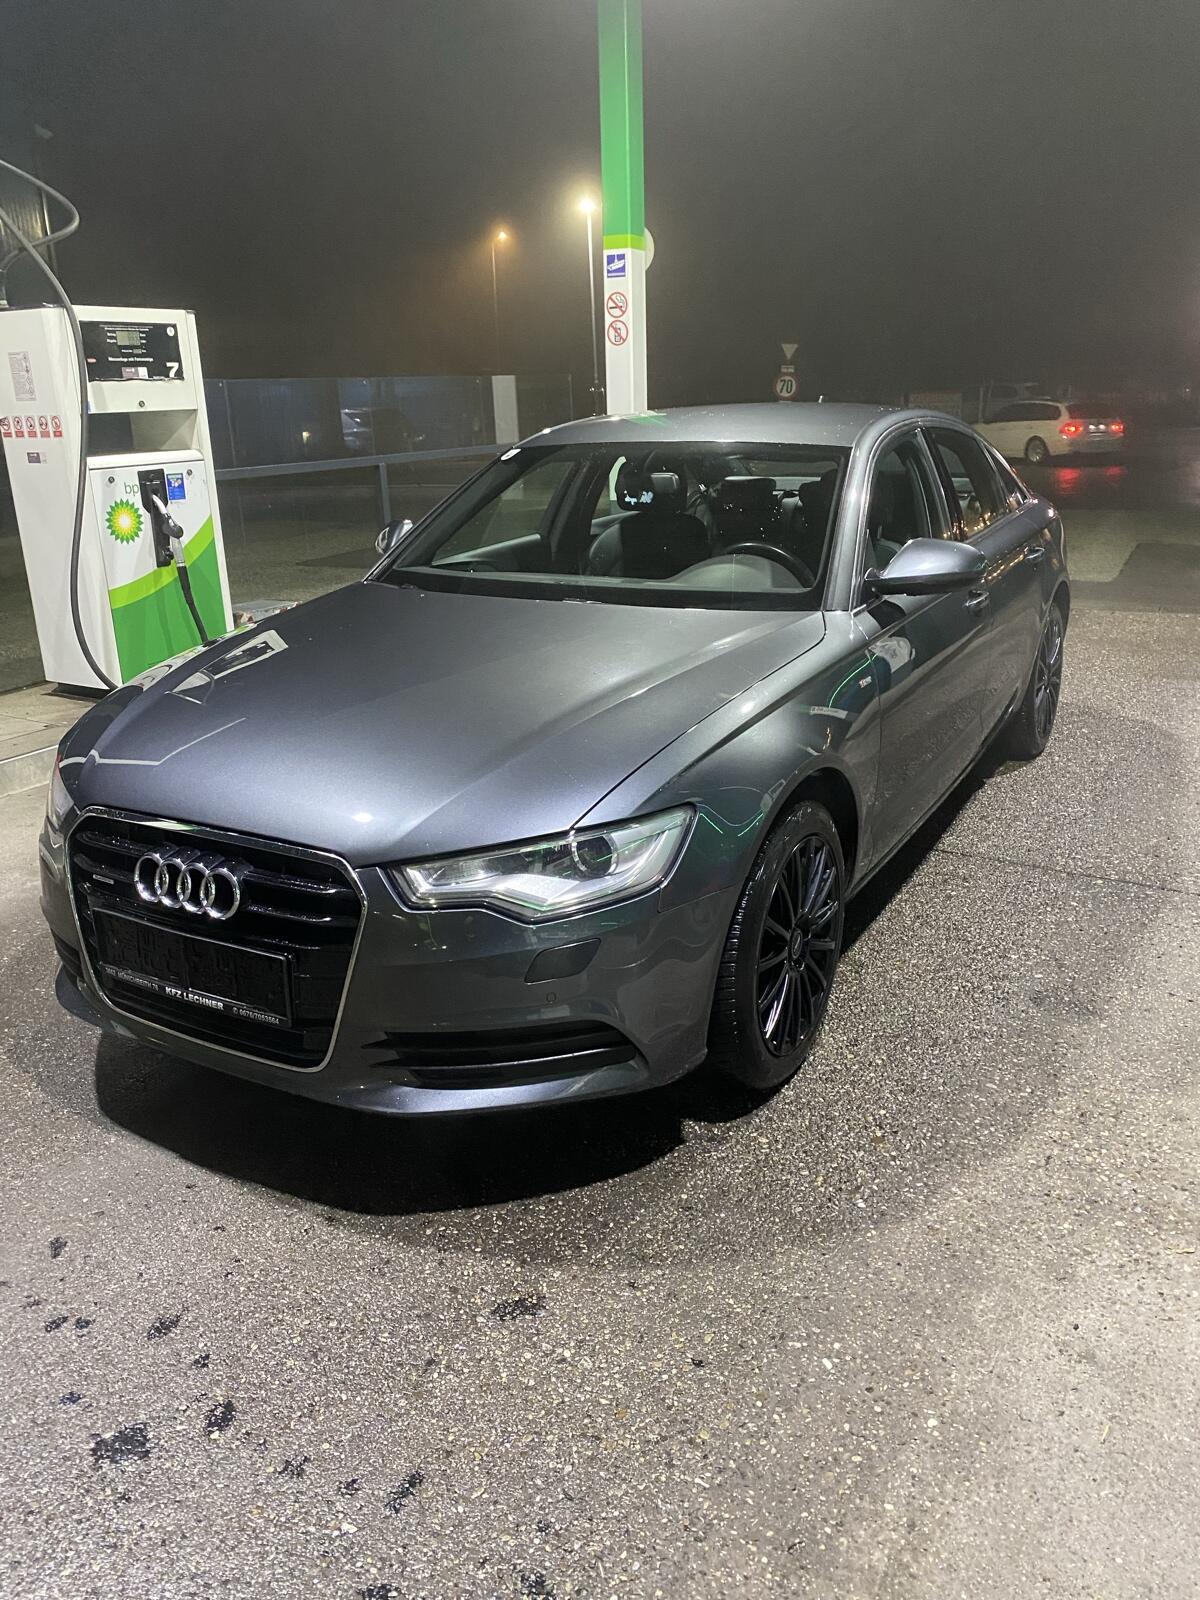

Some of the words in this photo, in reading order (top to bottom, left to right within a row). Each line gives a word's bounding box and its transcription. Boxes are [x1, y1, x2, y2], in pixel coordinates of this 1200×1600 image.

[166, 362, 179, 377] 7
[780, 379, 794, 394] 70
[124, 482, 140, 497] bp
[165, 986, 182, 998] KFZ
[183, 992, 224, 1010] LECHNER
